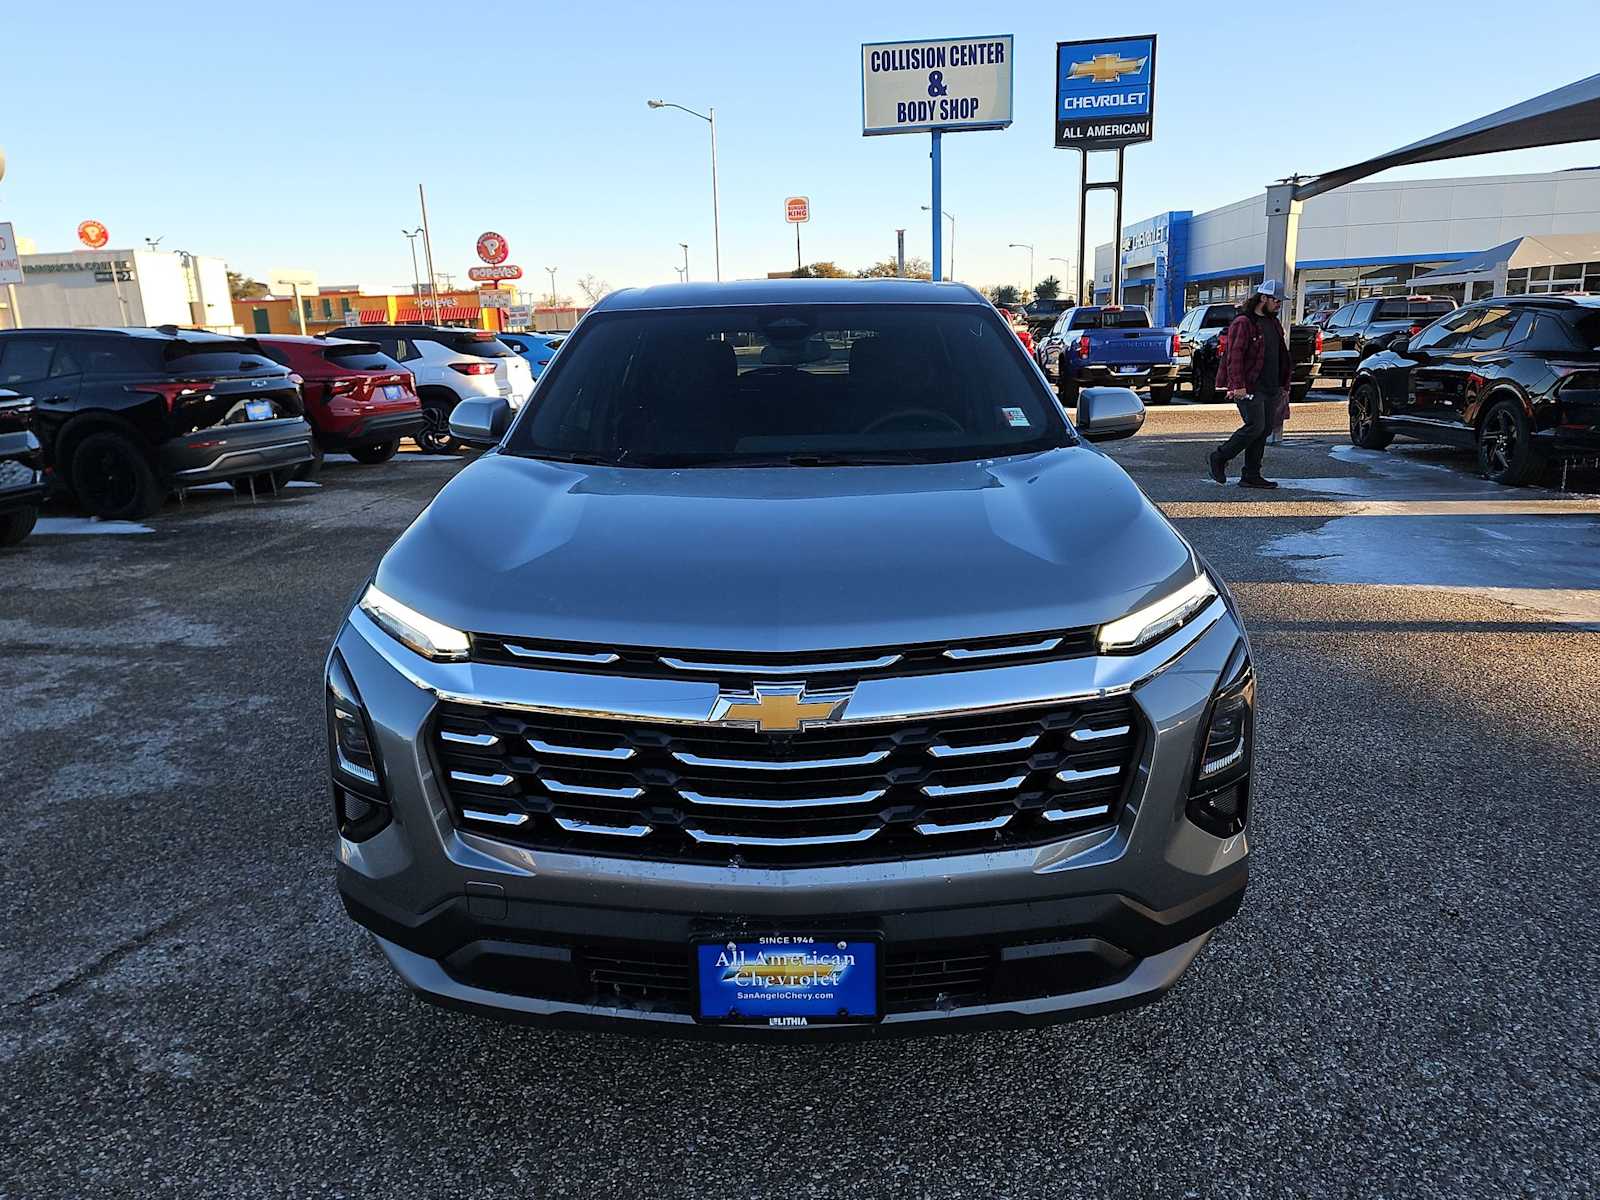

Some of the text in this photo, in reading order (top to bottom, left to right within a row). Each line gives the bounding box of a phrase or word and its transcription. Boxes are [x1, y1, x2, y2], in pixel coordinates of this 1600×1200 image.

[871, 42, 1004, 72] COLLISION CENTER
[928, 70, 948, 97] &
[1064, 92, 1146, 110] CHEVROLET
[897, 98, 979, 123] BODY SHOP
[1063, 122, 1146, 139] ALL AMERICAN
[759, 936, 815, 944] SINCE 1946
[715, 949, 856, 967] All American
[734, 971, 840, 988] Chevrolet
[737, 991, 834, 1001] SanAngeloChevy.com
